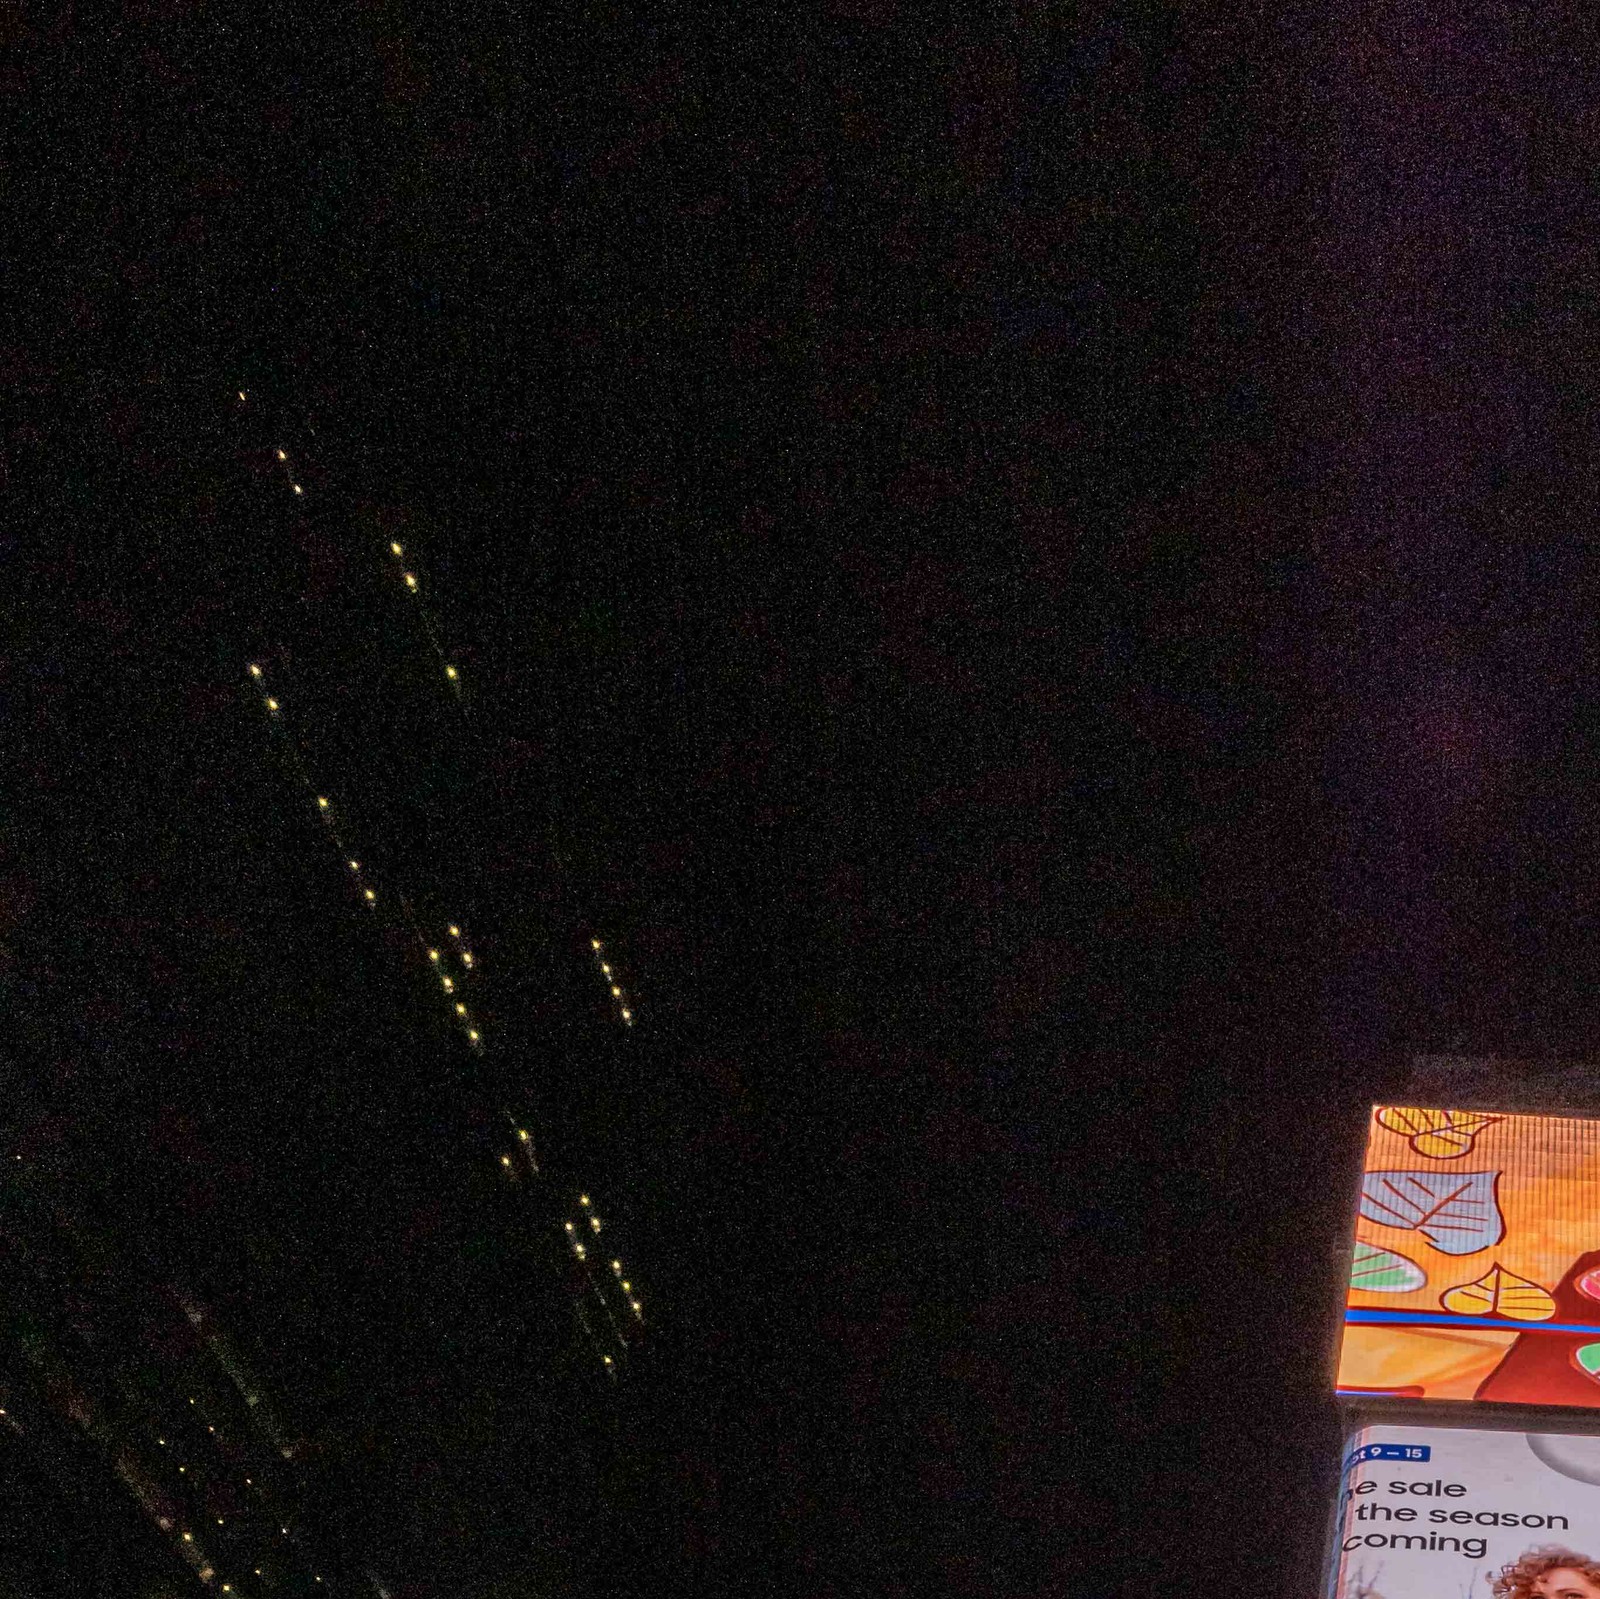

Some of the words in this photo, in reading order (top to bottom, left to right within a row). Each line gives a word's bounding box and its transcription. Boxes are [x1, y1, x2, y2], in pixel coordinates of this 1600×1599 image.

[1370, 1446, 1382, 1457] 9
[1405, 1447, 1422, 1459] 15
[1388, 1479, 1467, 1497] sale
[1355, 1503, 1417, 1522] the
[1428, 1509, 1569, 1530] season
[1342, 1531, 1488, 1559] coming
